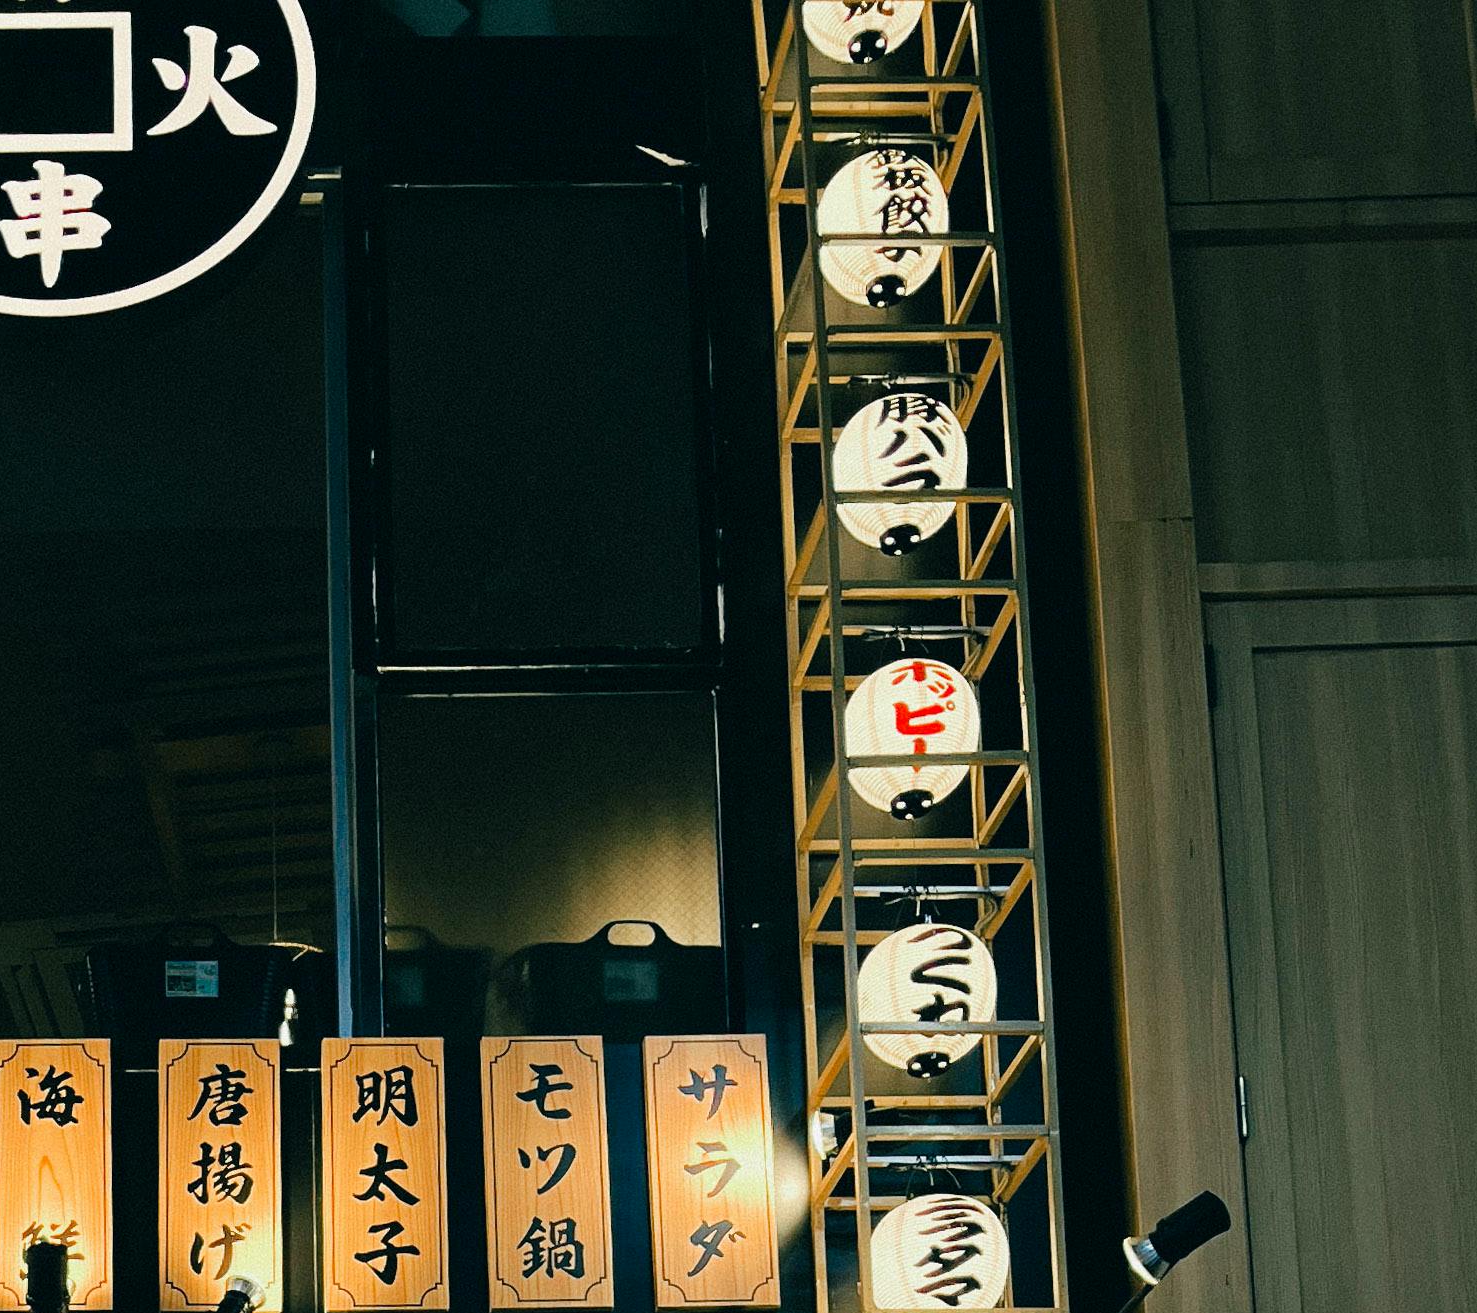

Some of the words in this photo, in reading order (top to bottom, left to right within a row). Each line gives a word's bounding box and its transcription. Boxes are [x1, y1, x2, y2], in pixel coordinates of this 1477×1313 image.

[888, 659, 956, 773] ホッピー
[186, 1064, 254, 1281] 唐揚げ
[351, 1065, 421, 1286] 明太子
[515, 1063, 585, 1279] モツ鍋
[676, 1063, 747, 1278] サラダ
